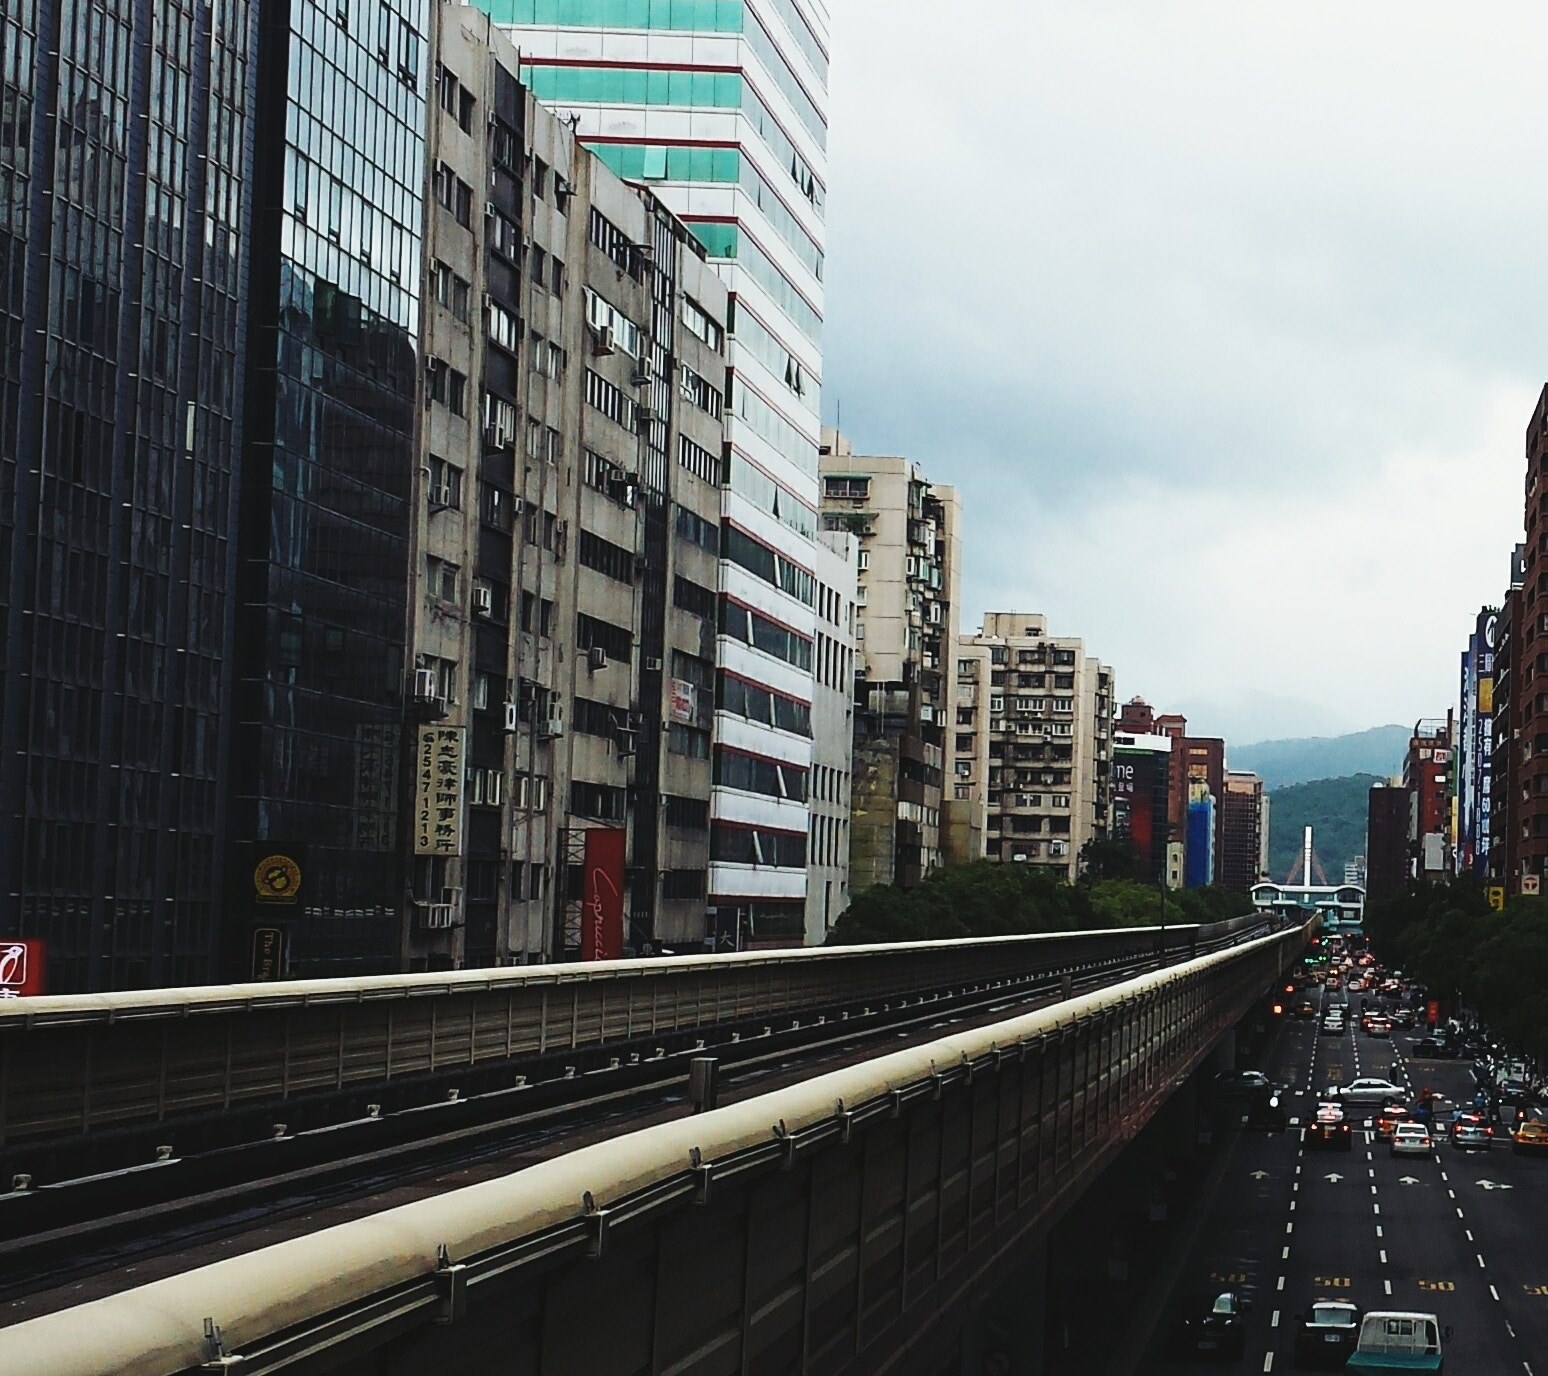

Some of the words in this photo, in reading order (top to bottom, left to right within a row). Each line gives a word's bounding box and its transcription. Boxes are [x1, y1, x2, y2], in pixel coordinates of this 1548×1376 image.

[263, 933, 274, 955] The
[1313, 1275, 1352, 1289] 50
[1417, 1279, 1457, 1292] 50
